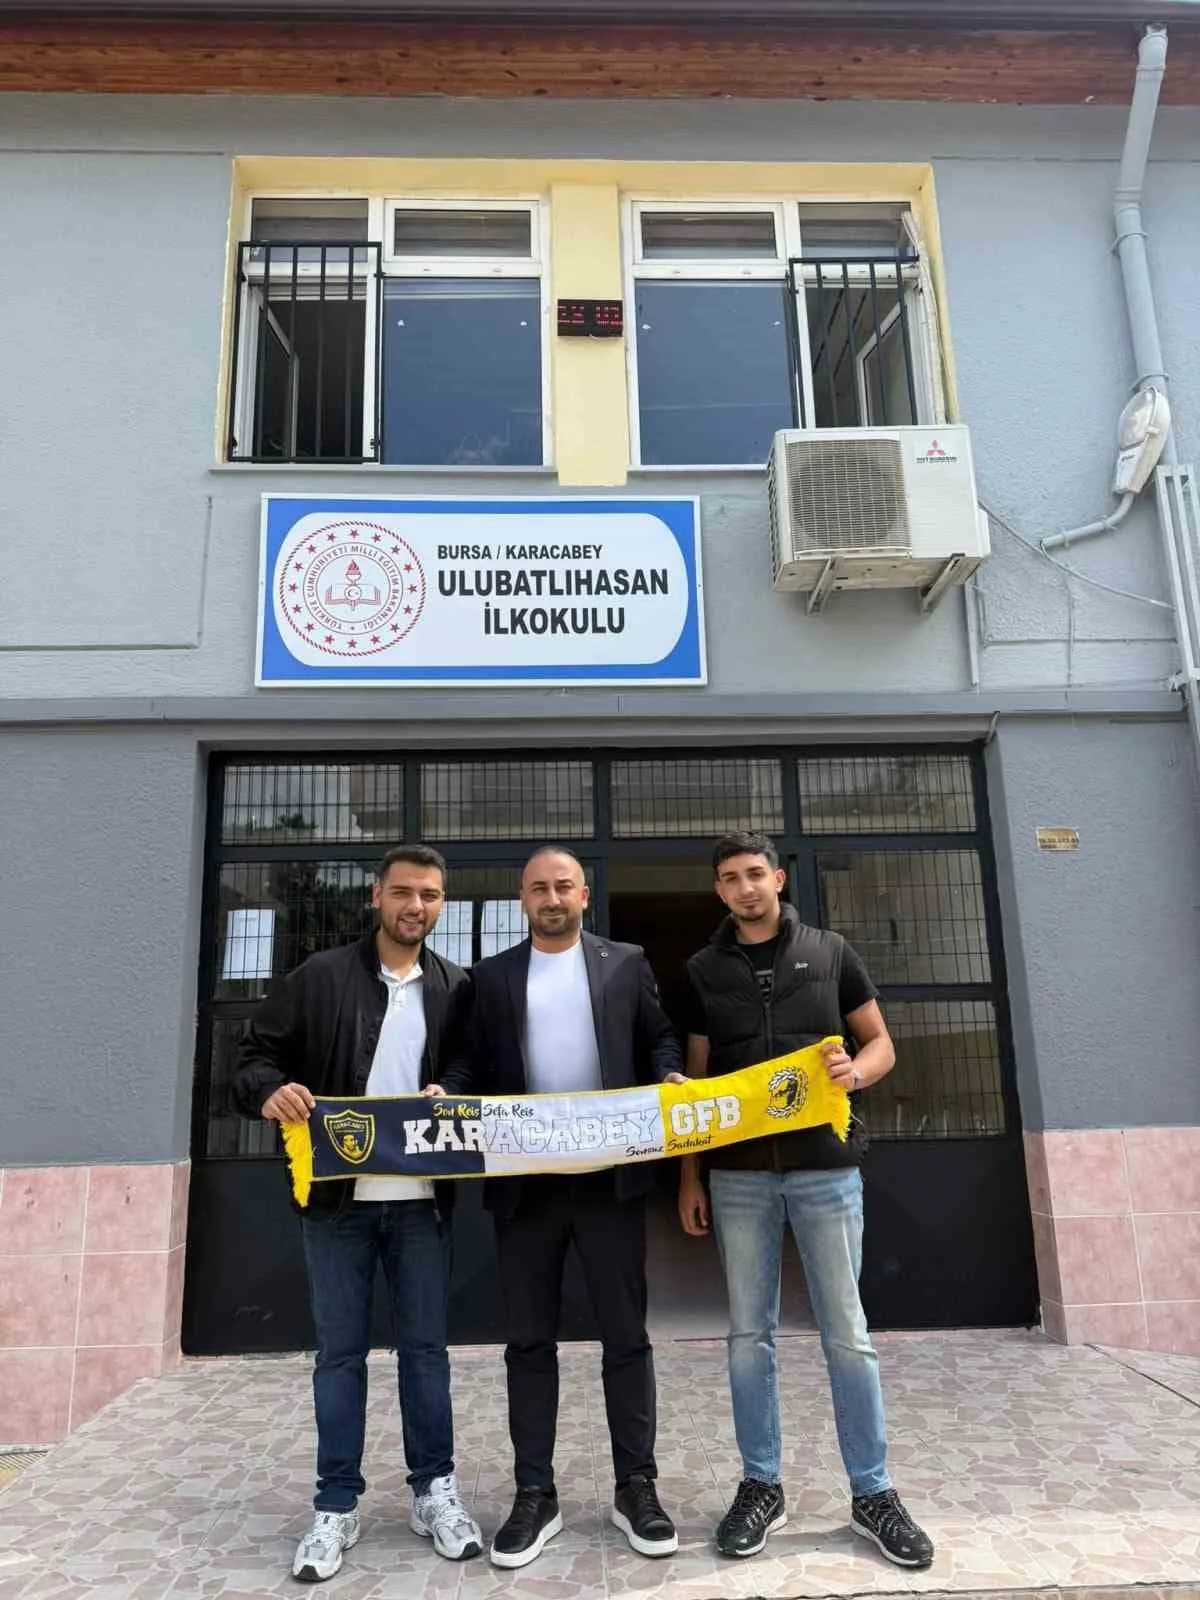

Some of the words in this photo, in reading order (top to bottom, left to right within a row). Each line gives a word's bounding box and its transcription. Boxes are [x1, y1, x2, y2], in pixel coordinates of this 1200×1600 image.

[351, 545, 377, 557] MİLLİ
[437, 545, 493, 560] BURSA
[496, 545, 502, 561] /
[505, 544, 603, 560] KARACABEY
[438, 569, 669, 597] ULUBATLIHASAN
[484, 602, 625, 635] İLKOKULU
[458, 1103, 480, 1119] Reis
[512, 1103, 535, 1119] Reis
[403, 1108, 660, 1154] KARACABEY
[671, 1094, 742, 1136] GFB
